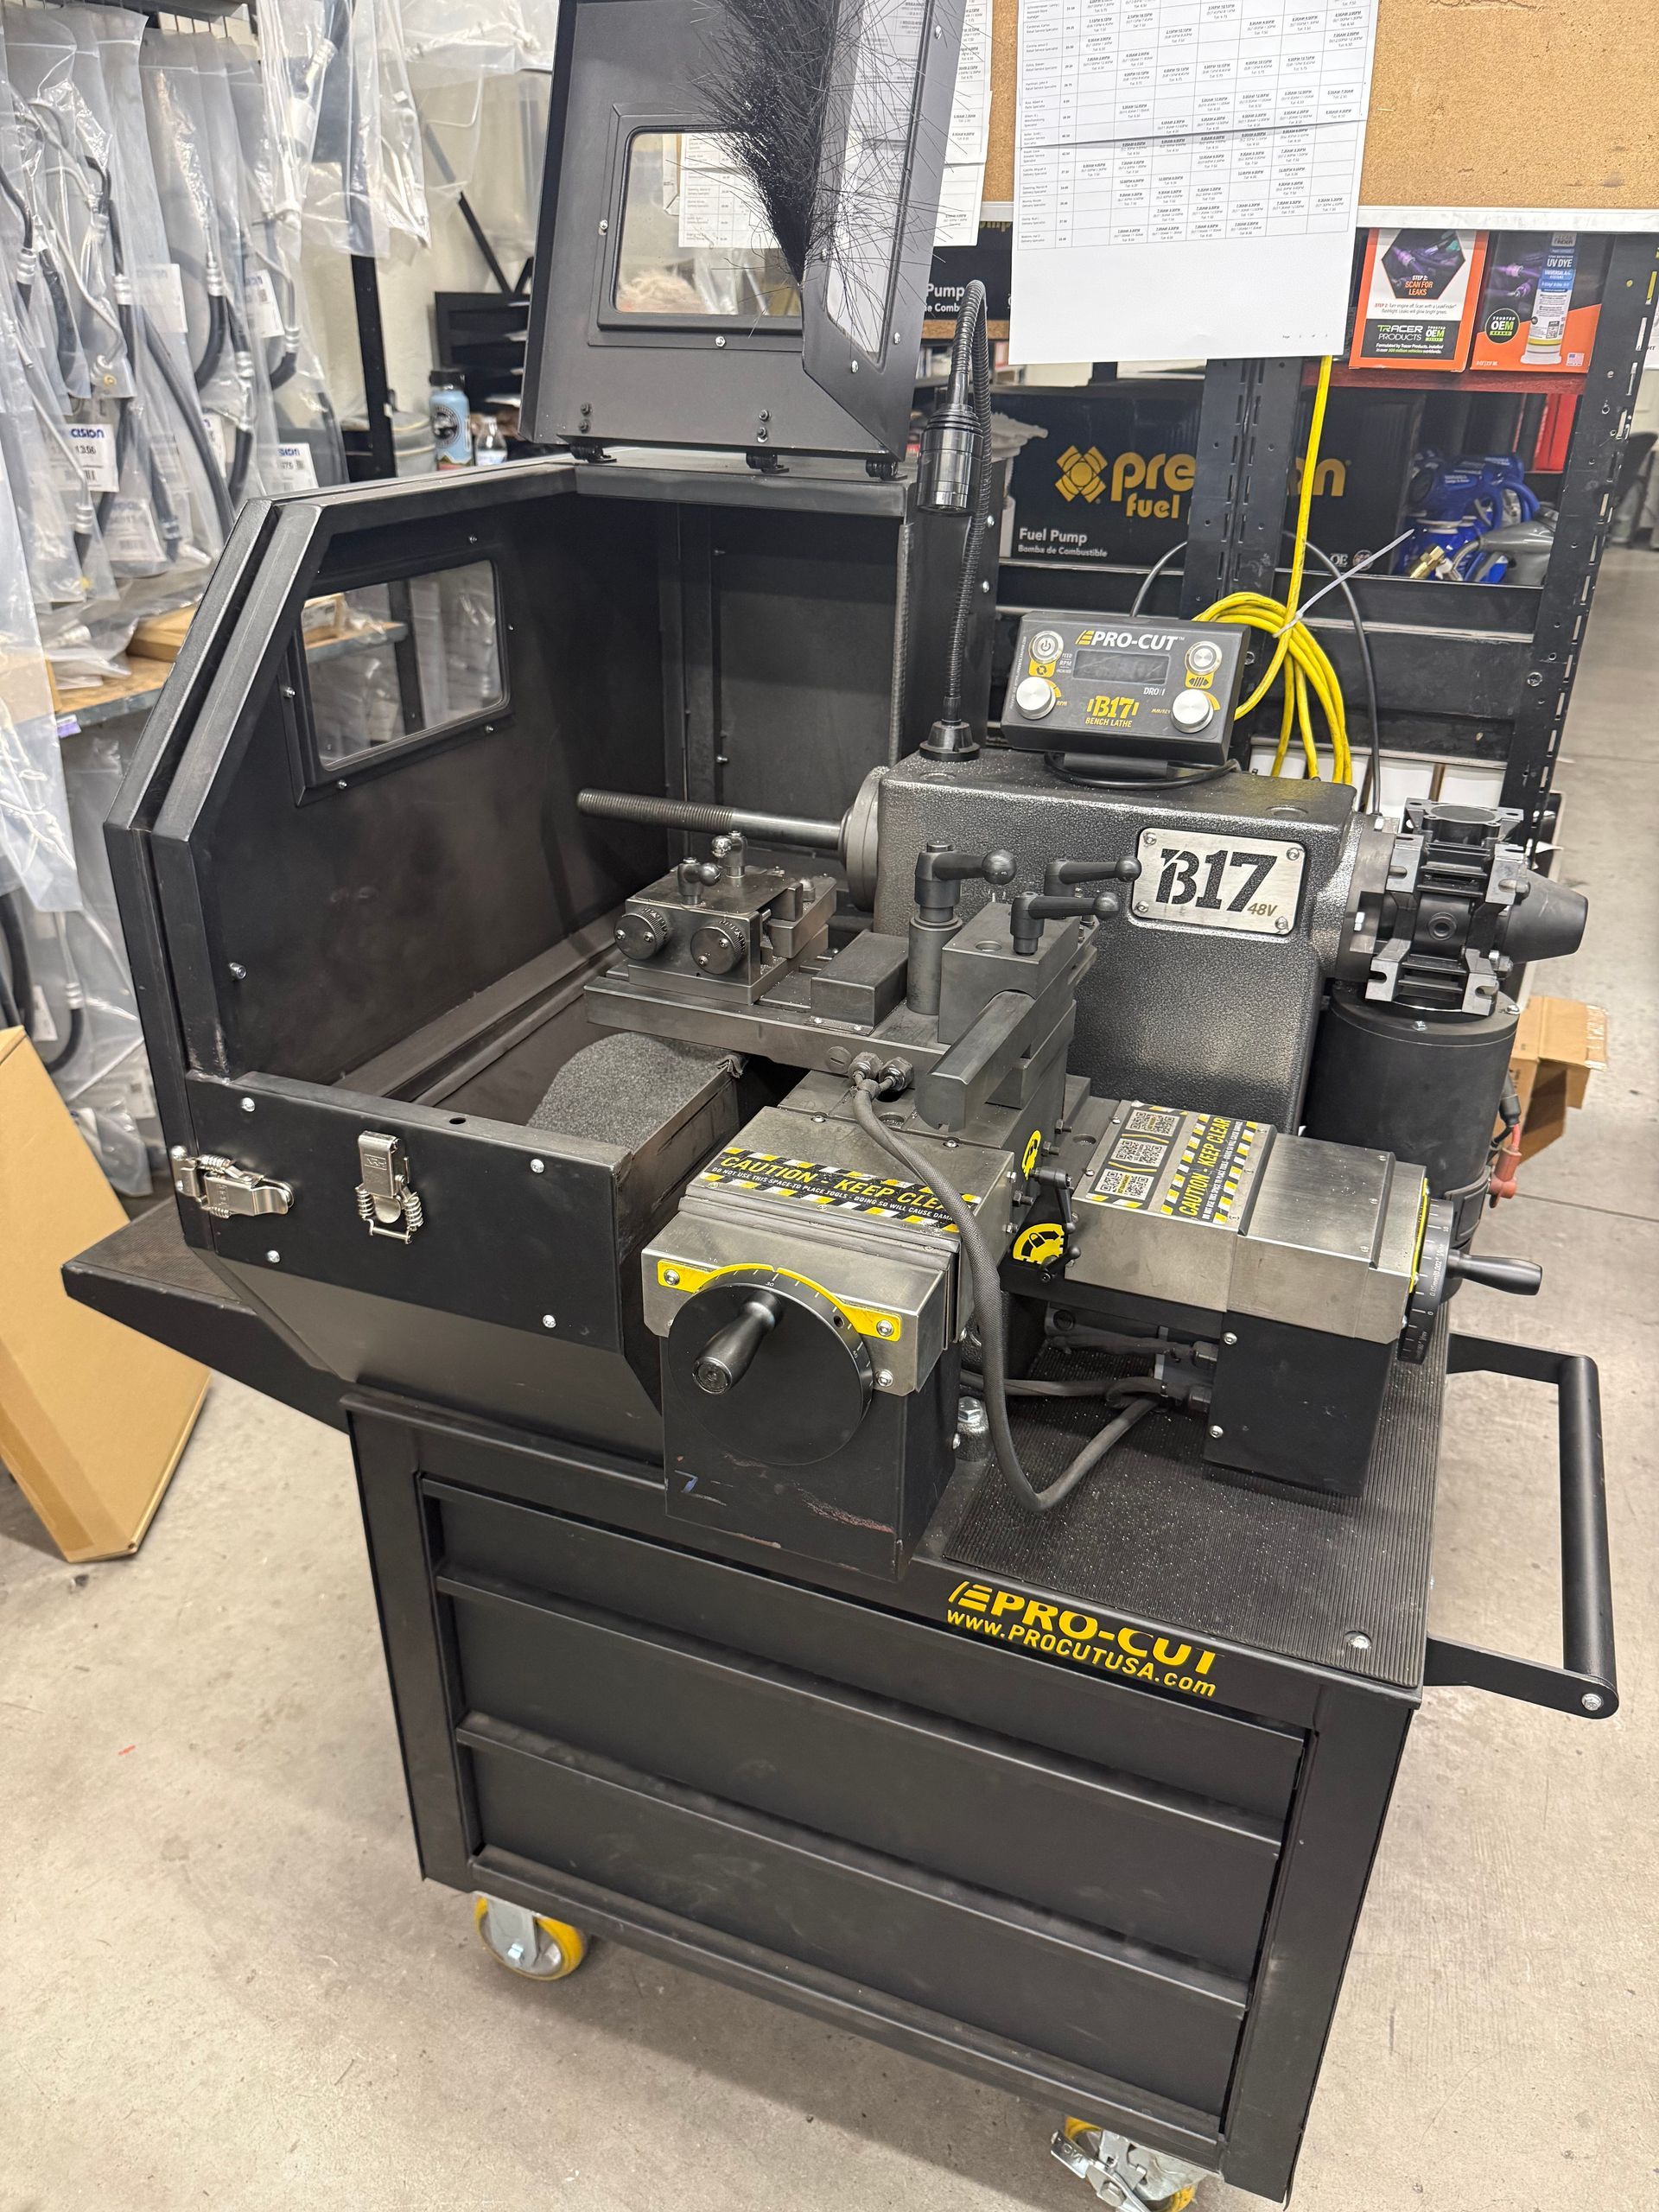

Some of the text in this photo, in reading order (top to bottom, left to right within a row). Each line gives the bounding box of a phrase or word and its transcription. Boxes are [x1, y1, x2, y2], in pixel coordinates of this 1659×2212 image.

[1558, 259, 1573, 268] DYE
[926, 283, 965, 301] Pump
[1377, 325, 1424, 334] TRACER
[1426, 329, 1445, 338] OEM
[1491, 321, 1515, 331] OEM
[1127, 493, 1180, 518] fuel
[1020, 527, 1088, 547] Fuel Pump
[1018, 544, 1108, 557] Bomba de Combustible
[1085, 717, 1133, 728] BENCH LATHE
[1156, 849, 1278, 912] B17
[1247, 903, 1279, 917] 48V
[1206, 1117, 1231, 1144] CLEAR
[1198, 1143, 1222, 1167] KEEP
[721, 1157, 819, 1183] CAUTION
[833, 1179, 895, 1198] KEEP
[768, 1179, 791, 1187] SPACE
[802, 1185, 826, 1194] PLACE
[826, 1190, 849, 1199] TOOLS
[854, 1197, 877, 1205] DOING
[890, 1203, 906, 1211] WILL
[908, 1207, 932, 1217] CAUSE
[1179, 1172, 1211, 1217] CAUTION
[990, 1591, 1225, 1675] PRO-CUT
